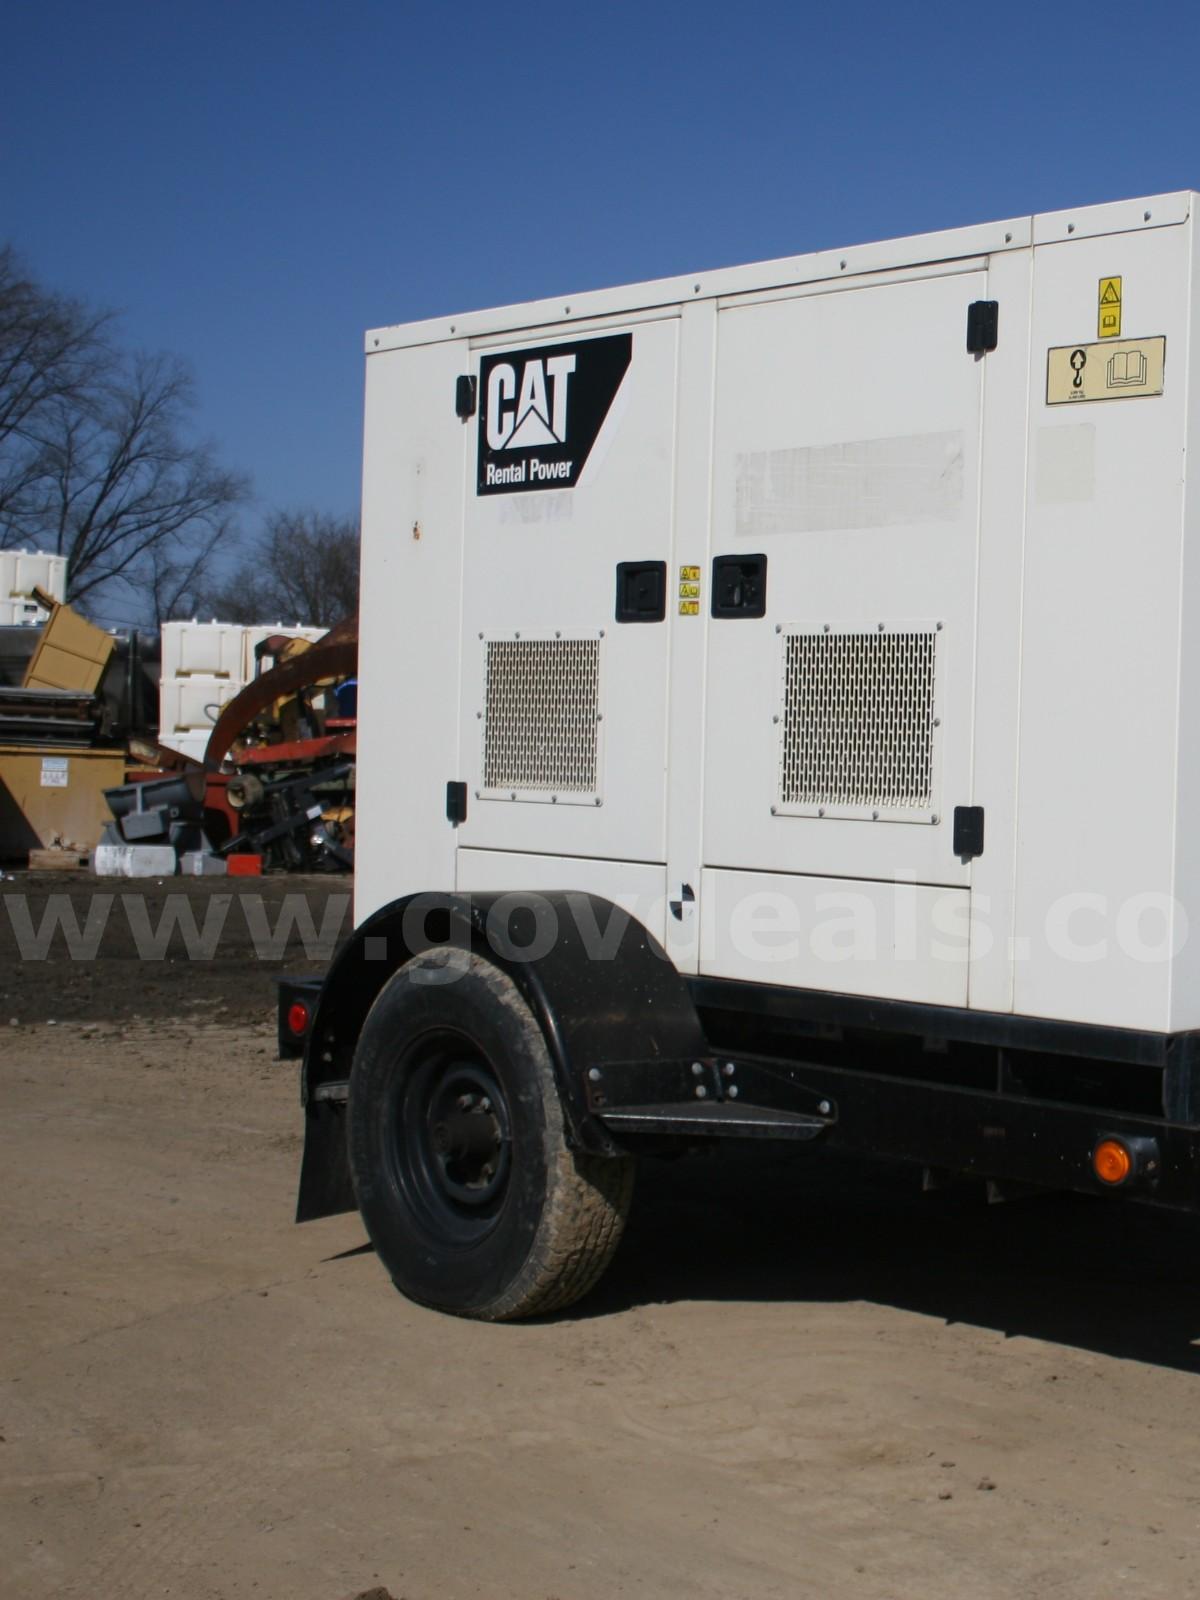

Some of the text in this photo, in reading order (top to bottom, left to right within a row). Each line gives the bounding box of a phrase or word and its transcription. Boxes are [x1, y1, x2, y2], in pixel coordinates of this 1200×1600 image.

[486, 354, 577, 451] CAT
[486, 458, 573, 486] Rental Power
